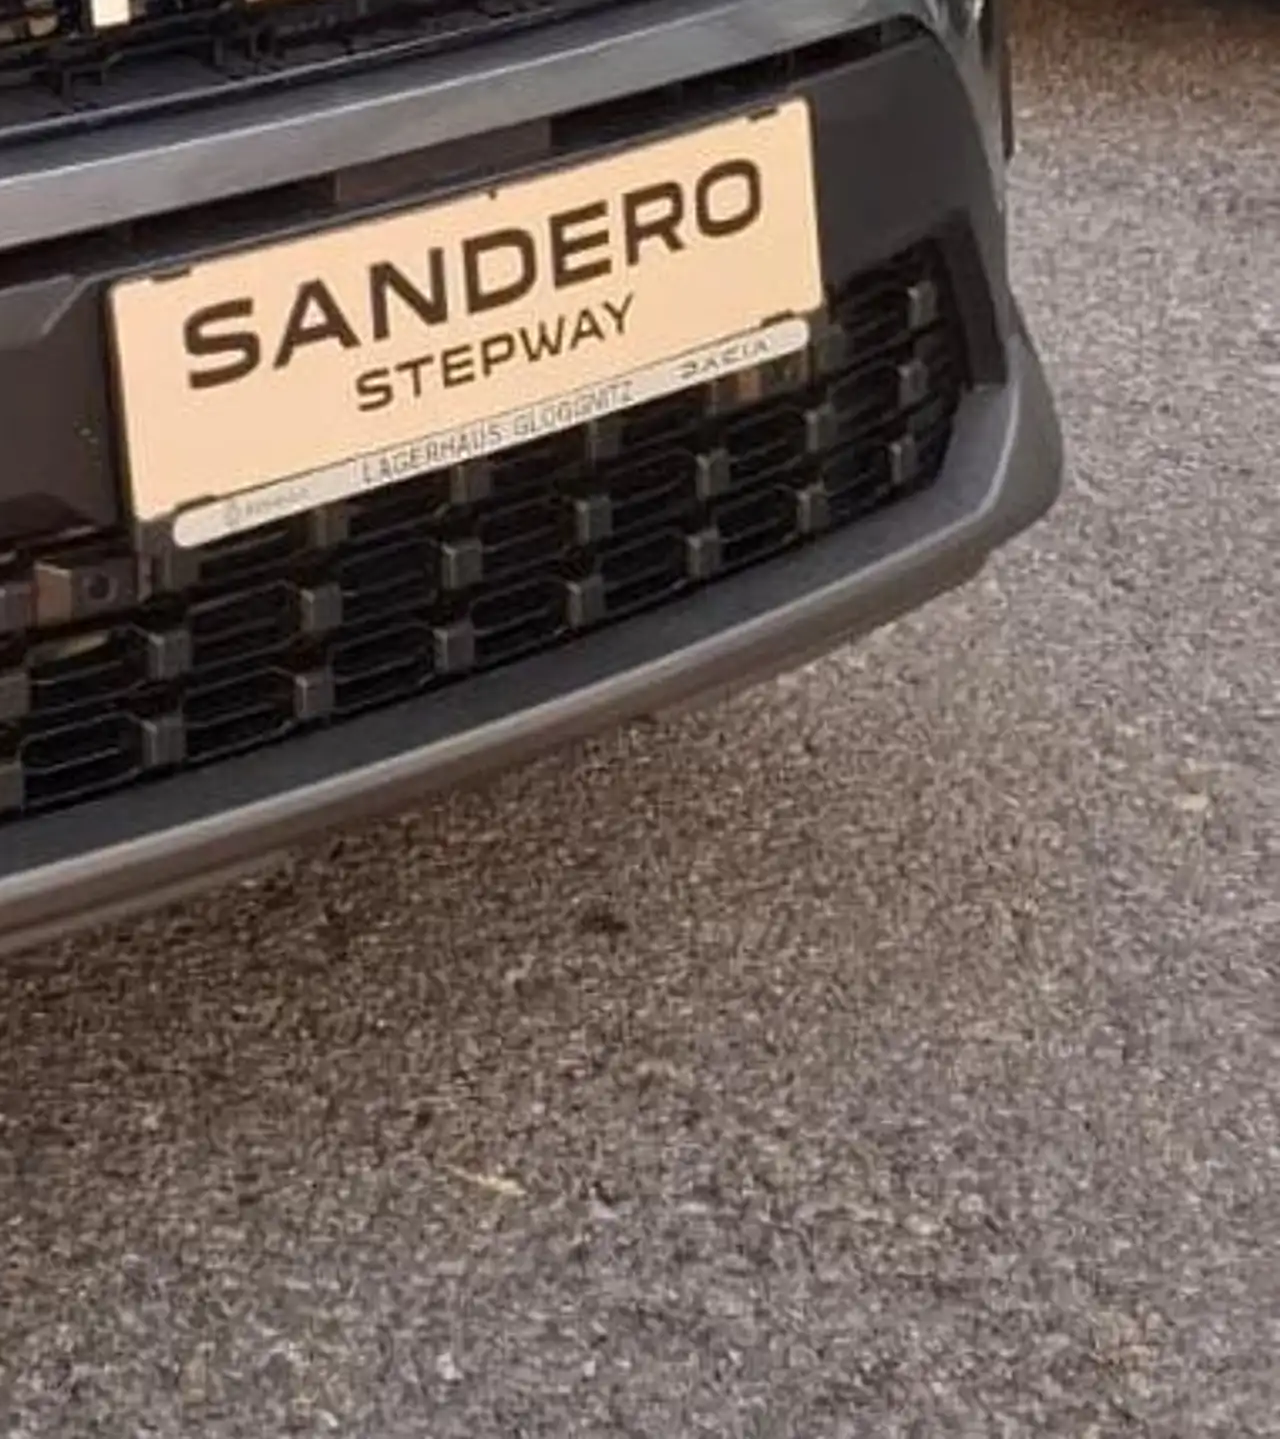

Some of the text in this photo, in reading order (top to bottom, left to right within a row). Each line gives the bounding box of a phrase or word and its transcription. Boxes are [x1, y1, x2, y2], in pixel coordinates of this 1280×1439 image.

[182, 158, 763, 390] SANDERO
[354, 294, 636, 412] STEPWAY
[361, 424, 504, 484] LAGERHAUS
